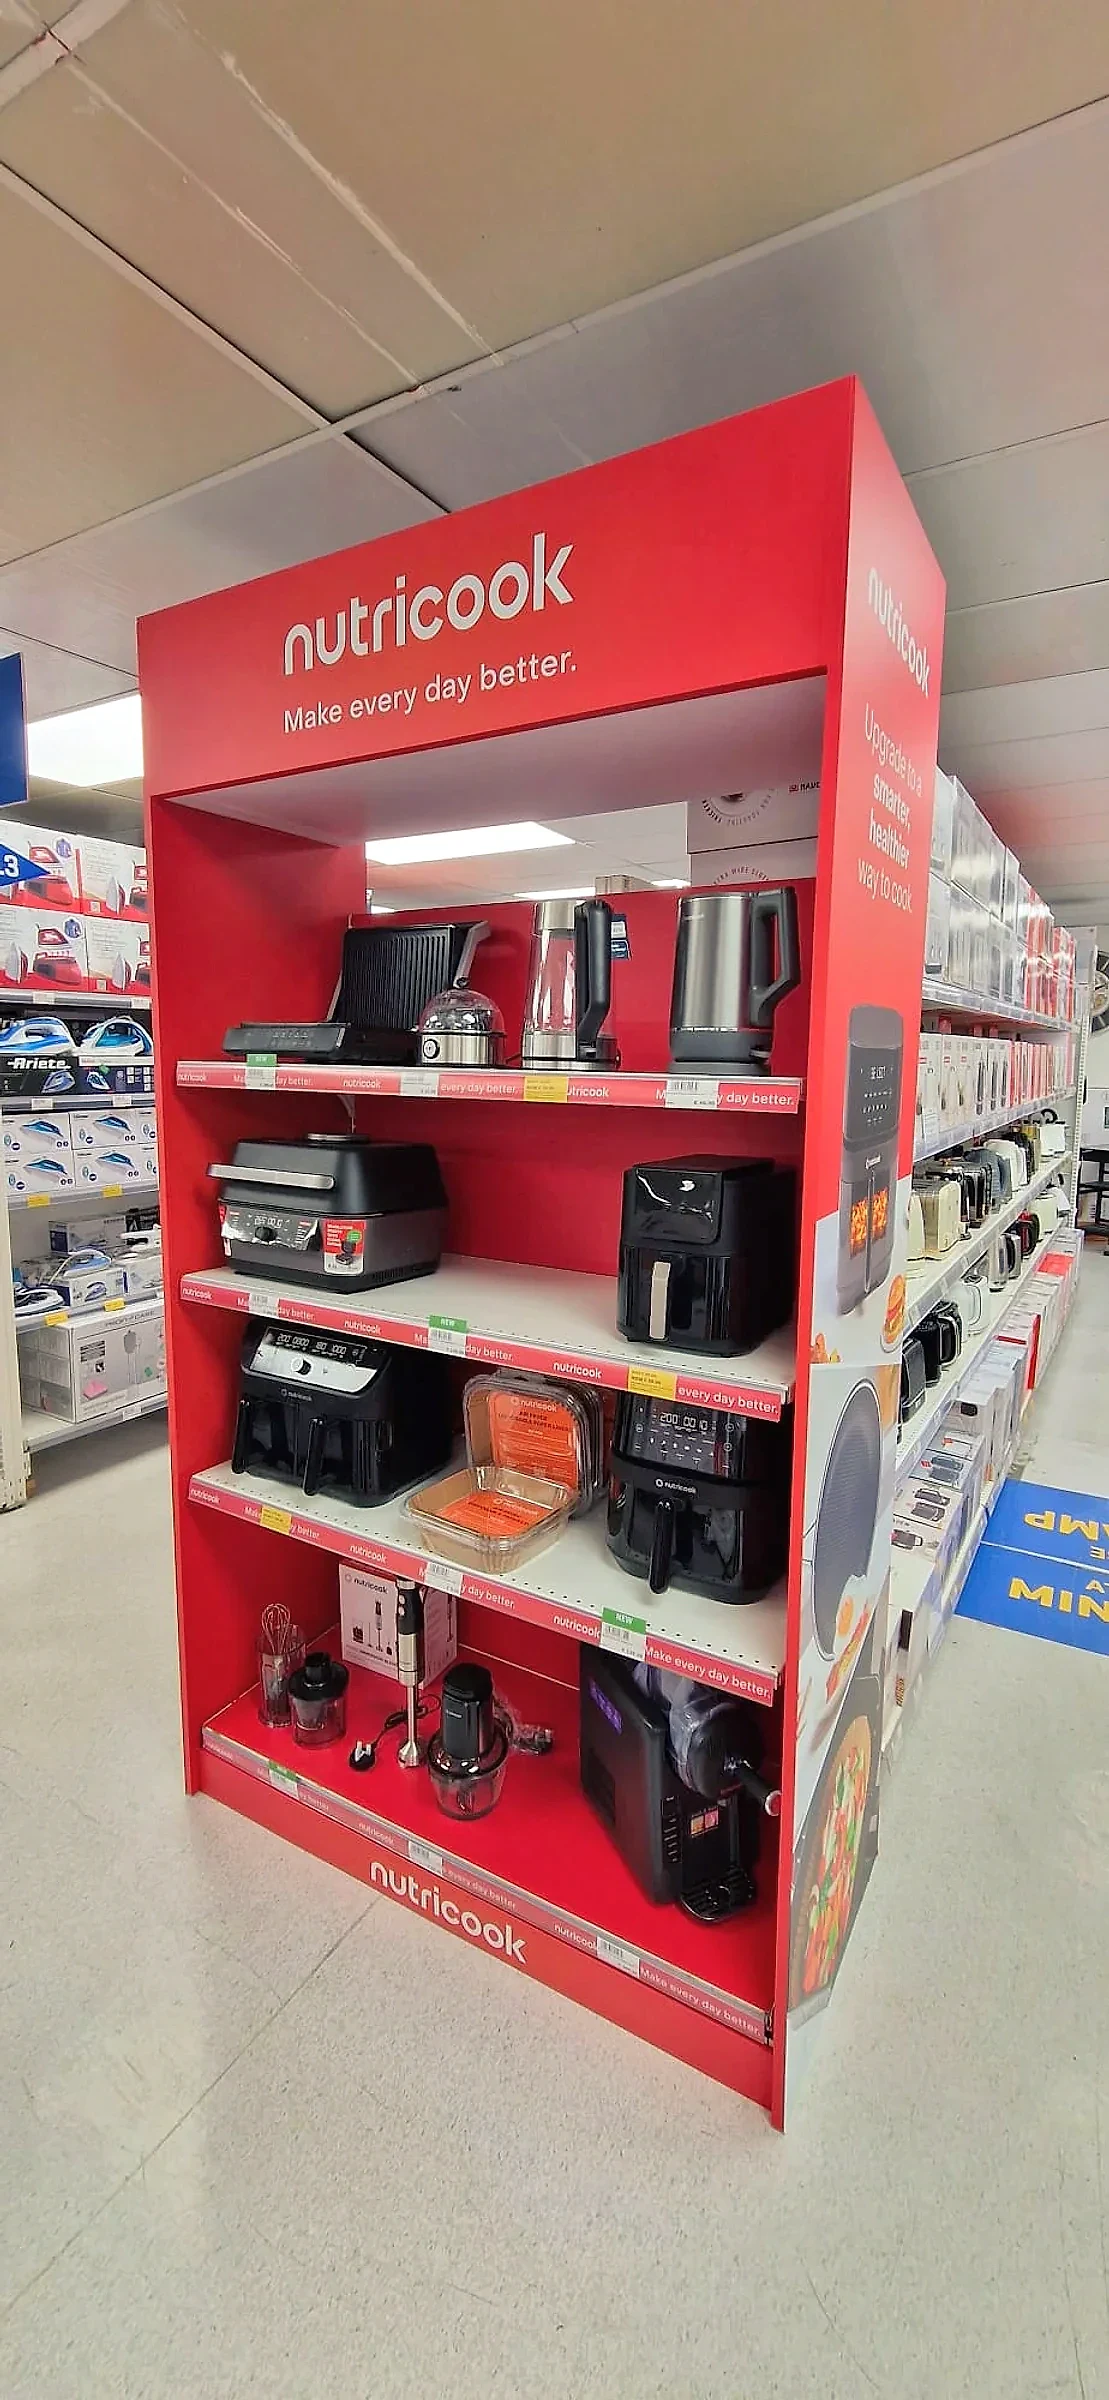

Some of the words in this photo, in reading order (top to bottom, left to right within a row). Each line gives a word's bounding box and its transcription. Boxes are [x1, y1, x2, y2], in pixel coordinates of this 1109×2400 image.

[284, 531, 574, 676] nutricook
[868, 567, 930, 698] nutricook
[284, 701, 342, 733] Make
[349, 686, 418, 714] every
[425, 673, 472, 704] day
[480, 650, 577, 691] better.
[865, 703, 907, 779] Upgrade
[907, 764, 916, 790] to
[916, 777, 924, 797] a
[873, 772, 911, 834] smarter,
[869, 808, 910, 871] healthier
[0, 854, 19, 878] 3
[858, 857, 878, 901] way
[879, 866, 892, 900] to
[892, 875, 913, 914] cook
[8, 1058, 71, 1070] Ariete
[178, 1073, 207, 1082] nutricook
[233, 1075, 245, 1083] Ma
[289, 1076, 313, 1086] better.
[343, 1079, 381, 1088] nutricook
[441, 1084, 464, 1094] every
[468, 1083, 485, 1094] day
[487, 1083, 520, 1095] better.
[567, 1086, 609, 1098] utricook
[727, 1092, 748, 1105] day
[752, 1093, 794, 1106] better.
[182, 1286, 212, 1300] nutricook
[237, 1298, 249, 1308] Ma
[291, 1308, 316, 1321] better.
[344, 1319, 381, 1335] nutricook
[414, 1334, 428, 1346] Ma
[466, 1345, 481, 1358] day
[482, 1347, 513, 1363] better.
[553, 1362, 602, 1379] nutricook
[678, 1386, 710, 1404] every
[713, 1388, 734, 1408] day
[737, 1395, 778, 1414] better.
[660, 1412, 678, 1425] 200
[190, 1488, 220, 1504] nutricook
[1024, 1511, 1109, 1541] MP
[350, 1543, 388, 1564] nutricook
[468, 1583, 485, 1598] day
[486, 1588, 515, 1609] better.
[354, 1577, 388, 1594] nutricook
[615, 1613, 634, 1624] NEW
[553, 1615, 601, 1639] nutricook
[645, 1647, 671, 1665] Make
[674, 1655, 705, 1675] every
[708, 1666, 729, 1685] day
[732, 1676, 770, 1698] better.
[369, 1861, 527, 1965] nutricook
[670, 1976, 700, 2001] every
